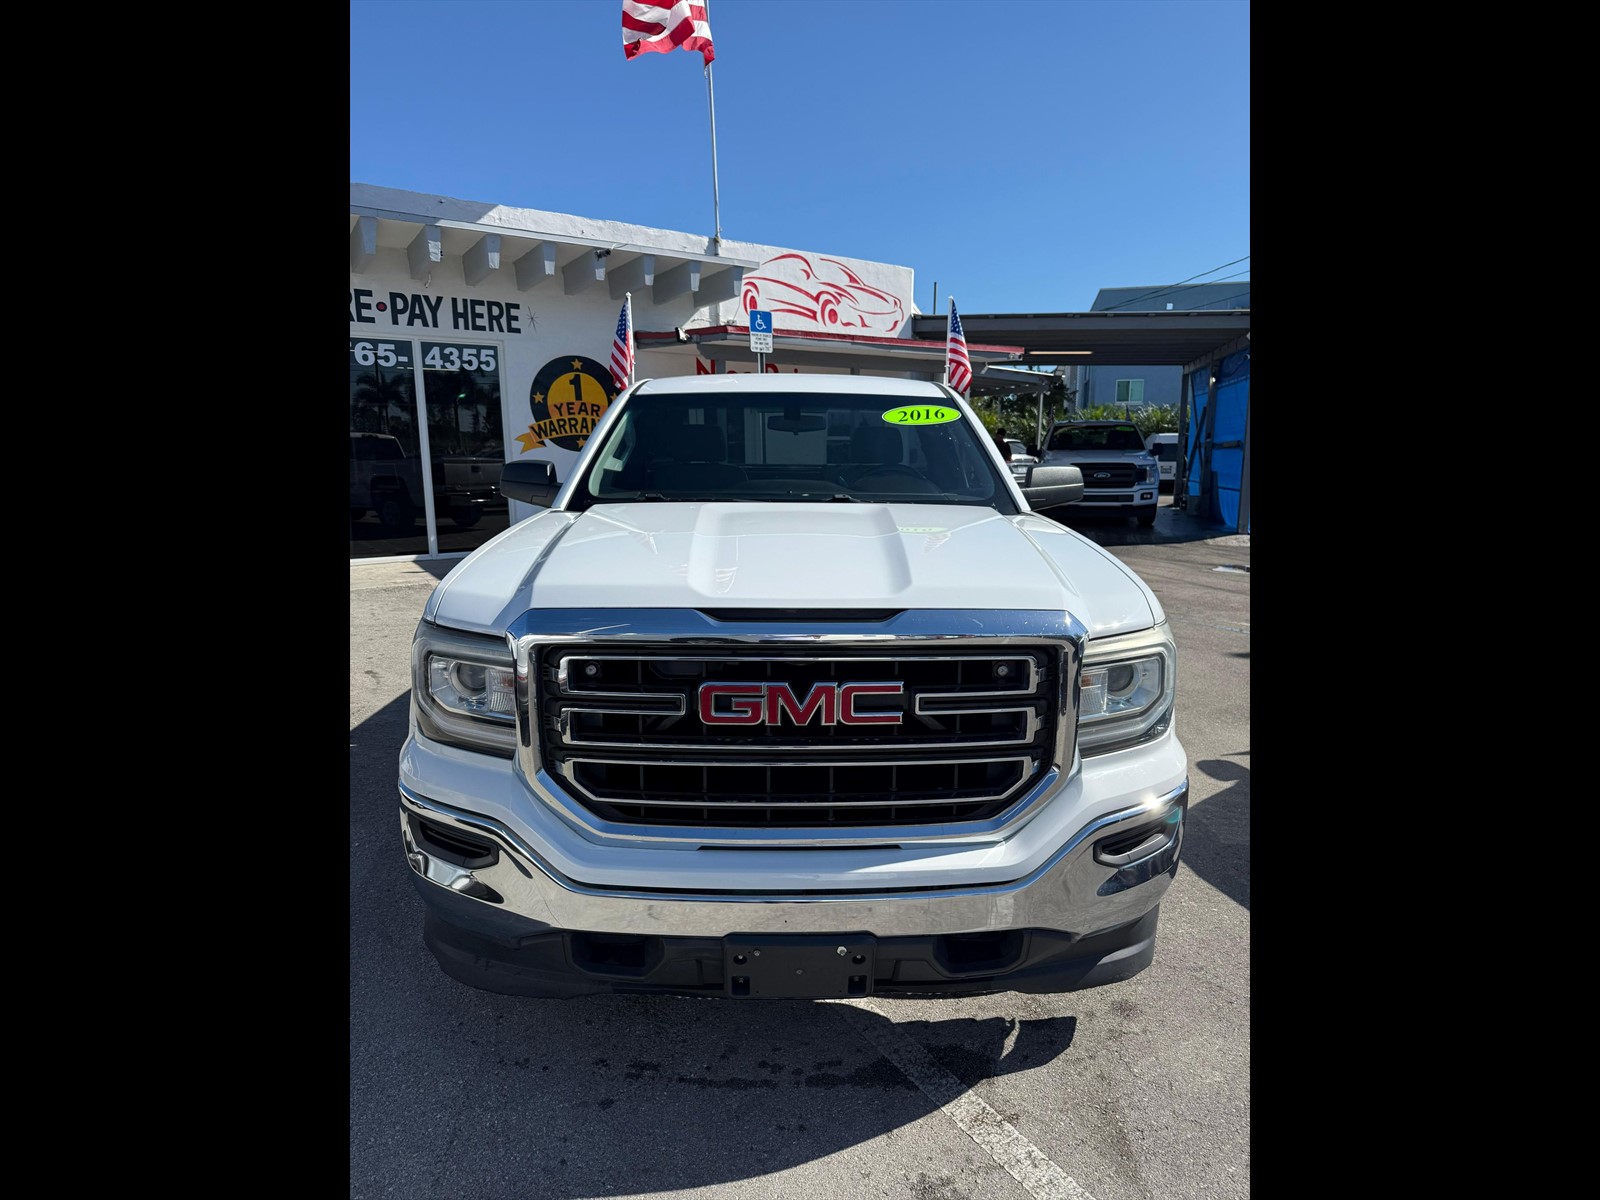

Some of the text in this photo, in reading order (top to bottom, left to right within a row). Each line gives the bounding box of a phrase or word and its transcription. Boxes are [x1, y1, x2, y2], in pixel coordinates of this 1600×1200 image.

[350, 288, 522, 334] E PAY HERE
[350, 342, 497, 372] 65- 4355
[569, 374, 583, 401] 1
[553, 401, 601, 417] YEAR
[897, 408, 945, 423] 2016
[699, 681, 904, 726] GMC
